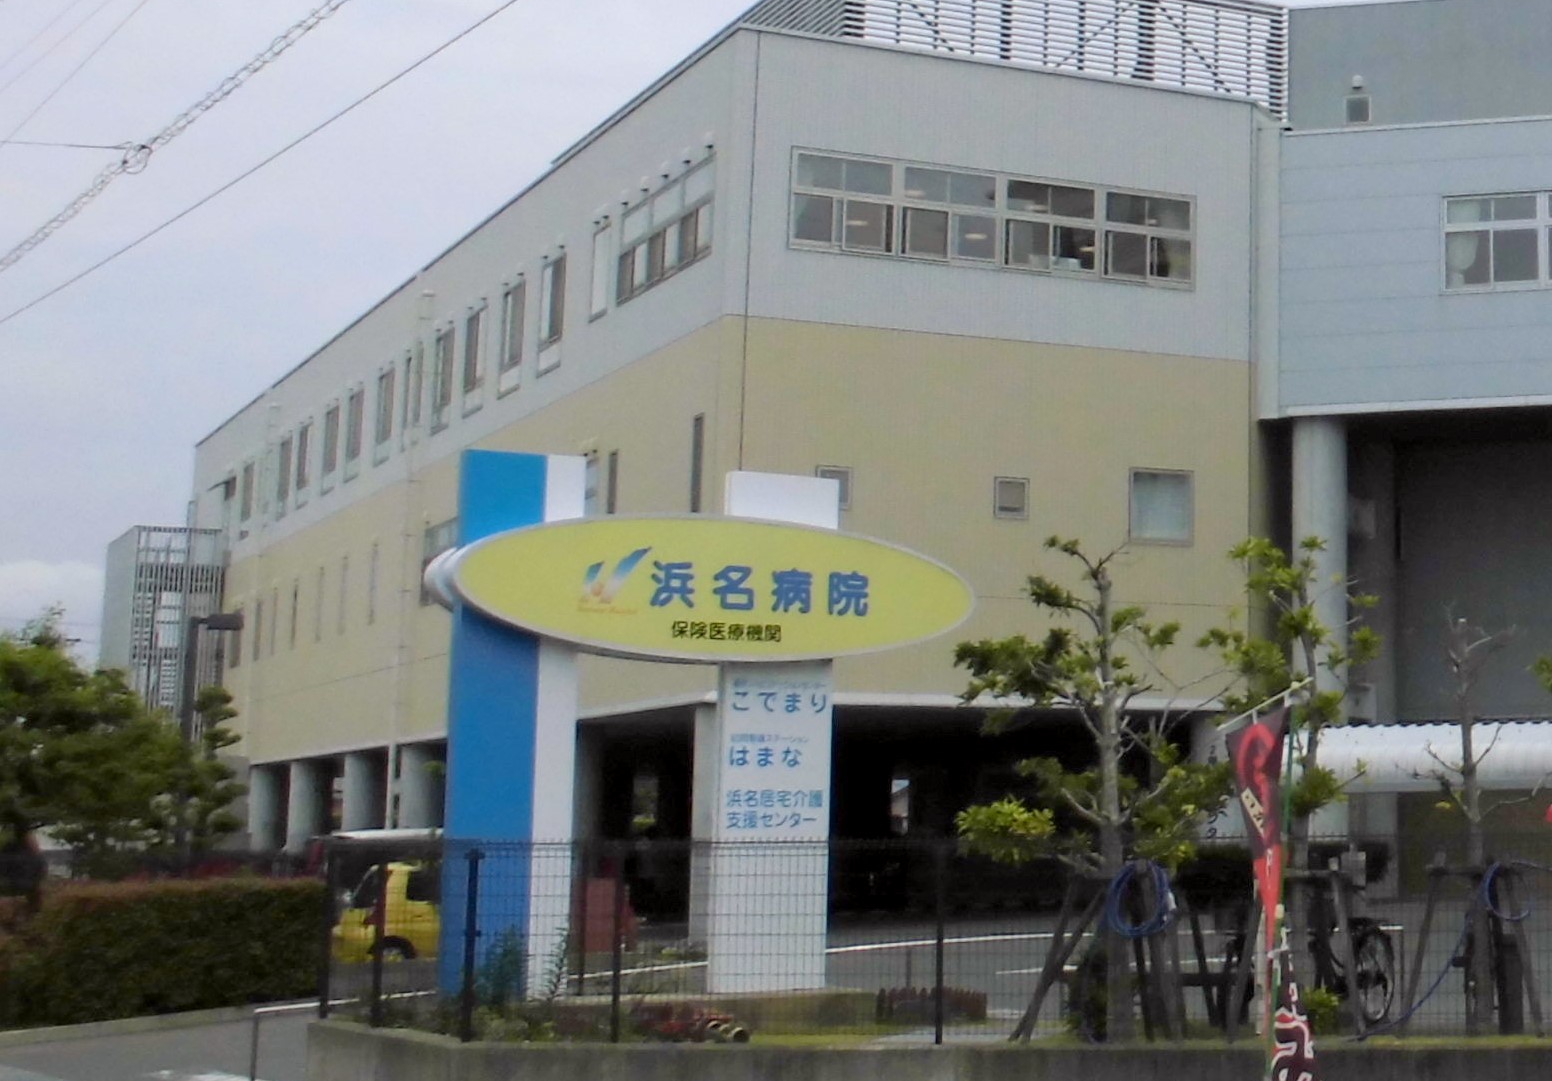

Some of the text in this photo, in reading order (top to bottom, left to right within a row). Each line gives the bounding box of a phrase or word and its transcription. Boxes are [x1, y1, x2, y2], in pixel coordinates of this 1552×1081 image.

[650, 560, 869, 617] 浜名病院
[671, 620, 782, 642] 保険医療機関
[729, 746, 803, 767] はまな
[726, 810, 817, 829] 支援センター
